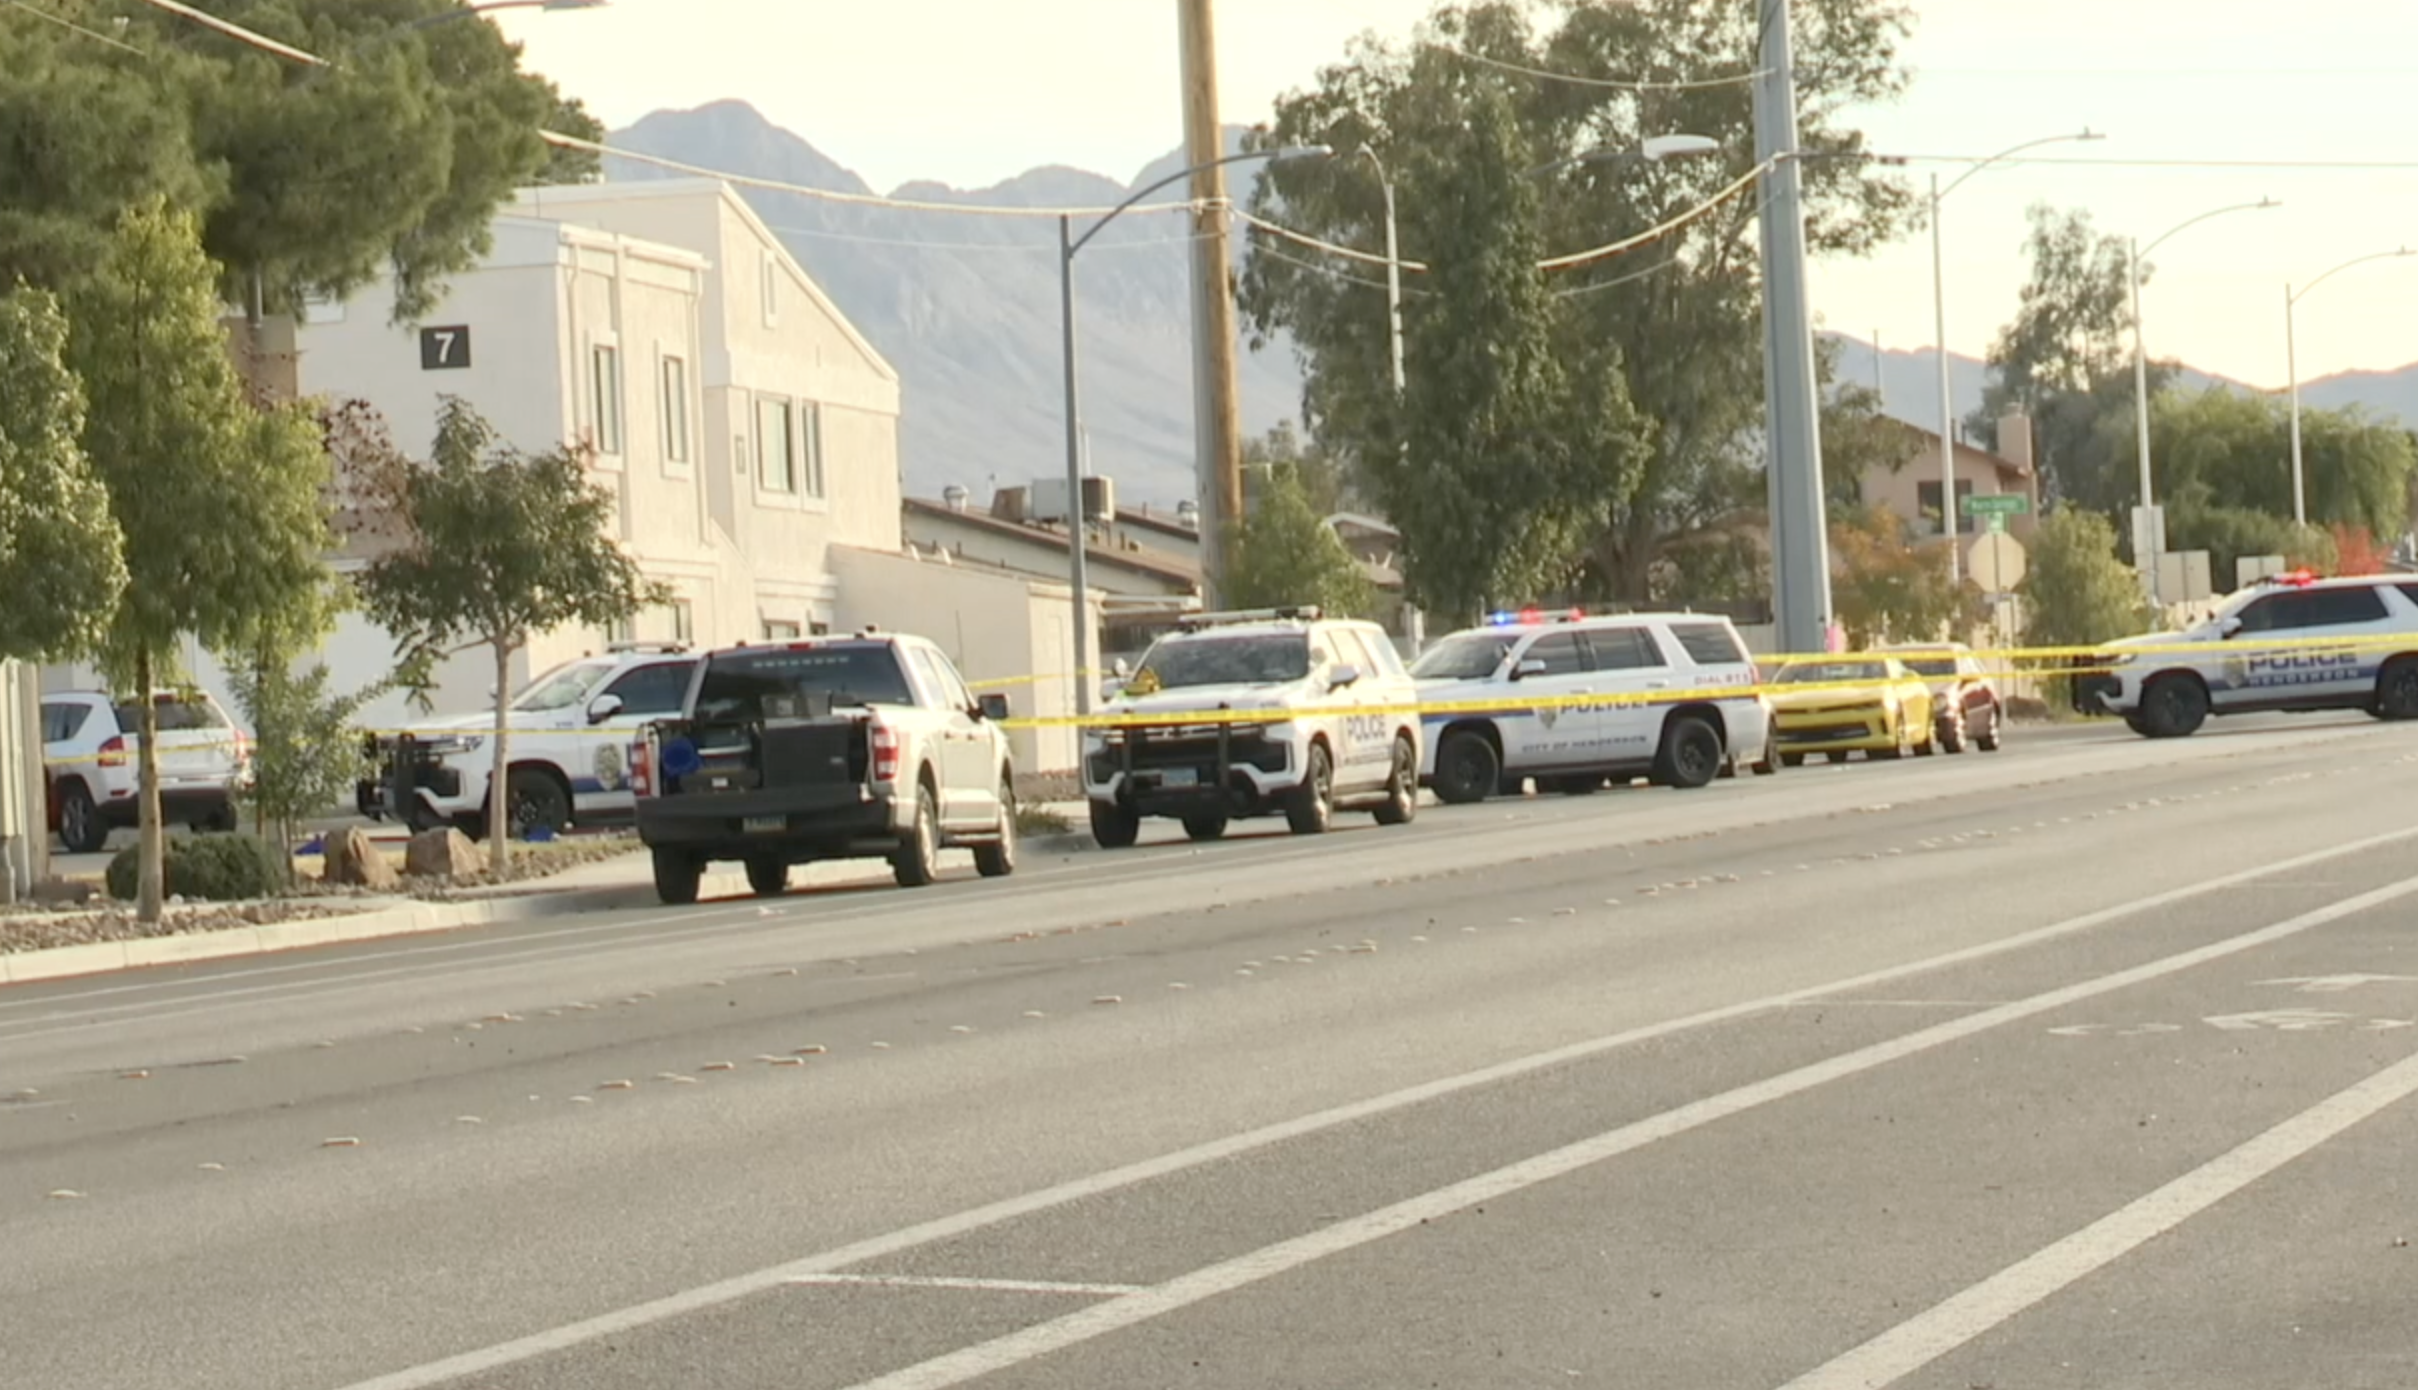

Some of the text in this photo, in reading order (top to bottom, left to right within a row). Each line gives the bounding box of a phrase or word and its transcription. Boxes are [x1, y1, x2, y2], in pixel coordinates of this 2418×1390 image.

[434, 332, 455, 363] 7
[2248, 644, 2357, 672] POLICE
[1694, 675, 1721, 686] DIAL
[2249, 669, 2359, 686] HENDERSON
[1346, 714, 1386, 741] POLICE
[1522, 742, 1549, 753] CITY
[1553, 741, 1568, 750] OF
